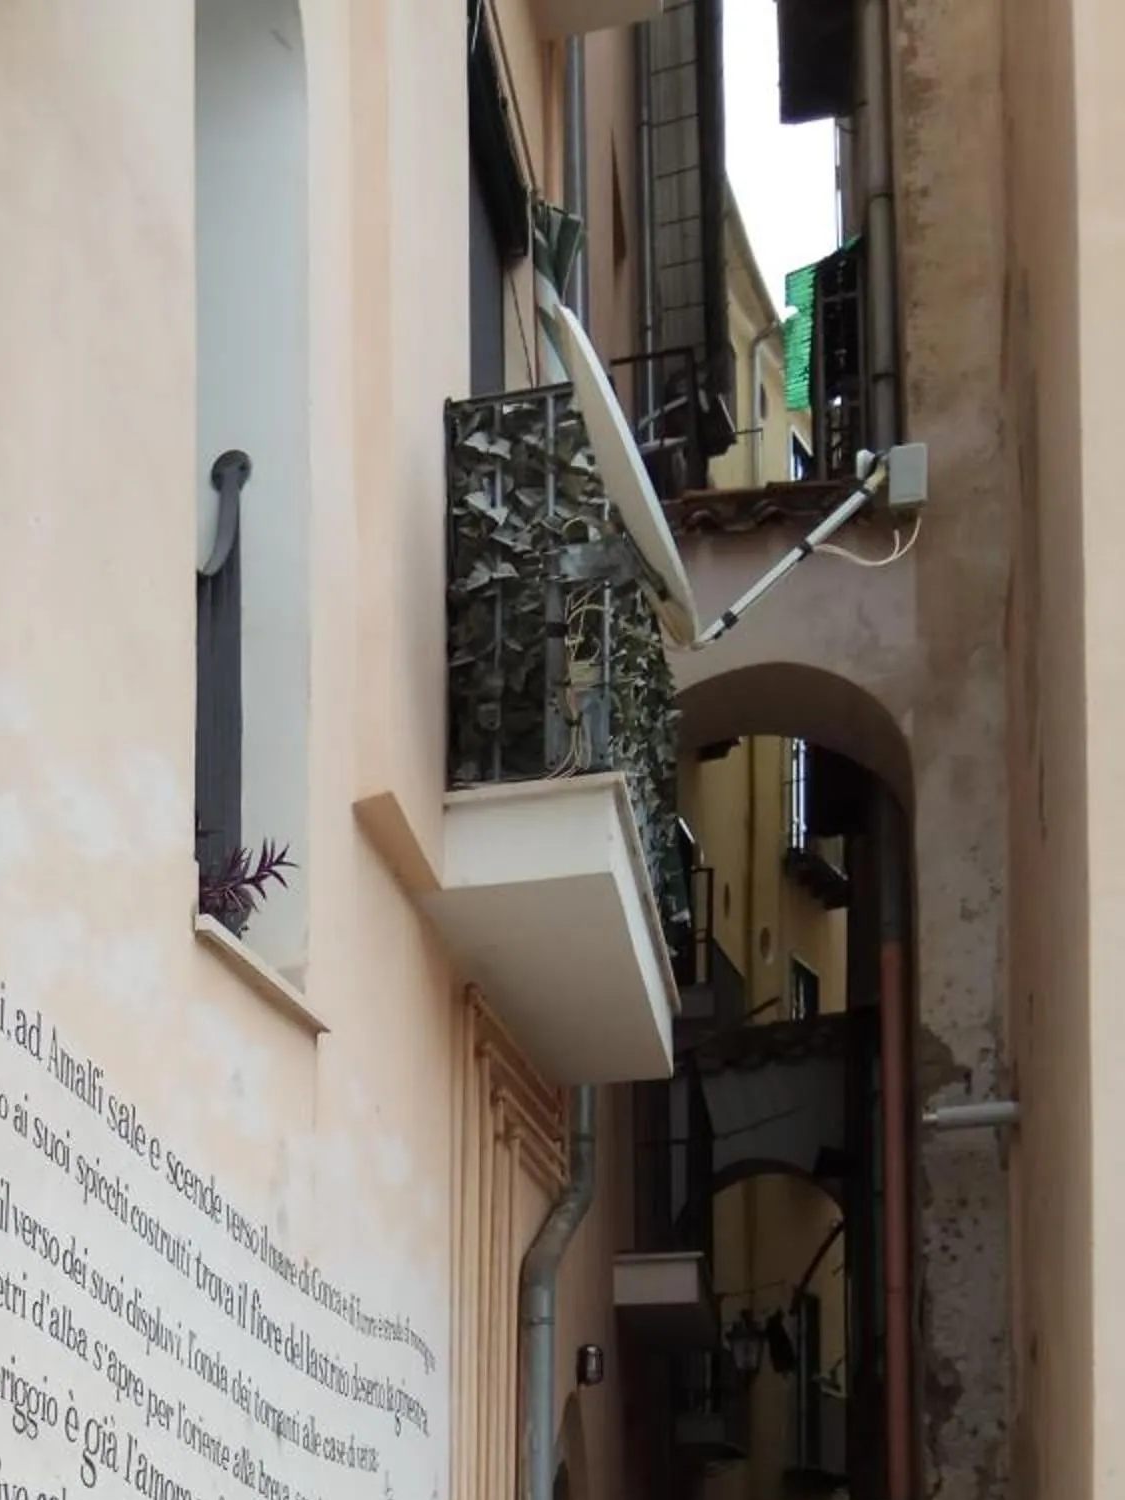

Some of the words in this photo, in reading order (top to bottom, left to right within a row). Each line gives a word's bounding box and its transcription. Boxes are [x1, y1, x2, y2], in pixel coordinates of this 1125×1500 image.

[13, 1094, 29, 1137] ai
[32, 1117, 71, 1175] suoi
[75, 1155, 129, 1222] spicchi
[130, 1203, 192, 1279] costrutti
[195, 1252, 236, 1319] trova
[238, 1282, 248, 1329] il
[250, 1288, 282, 1356] fiore
[285, 1322, 304, 1371] del
[15, 1006, 42, 1062] ad
[47, 1026, 105, 1115] Amalfi
[108, 1095, 147, 1157] sale
[149, 1137, 161, 1170] e
[165, 1148, 223, 1226] scende
[226, 1203, 259, 1255] verso
[260, 1225, 268, 1263] il
[12, 1206, 60, 1266] verso
[62, 1236, 88, 1288] dei
[90, 1270, 124, 1318] suoi
[187, 1328, 229, 1394] l'onda
[230, 1369, 251, 1416] dei
[302, 1414, 321, 1456] alle
[31, 1289, 90, 1362] d'alba
[93, 1339, 145, 1409] s'apre
[146, 1383, 175, 1432] per
[176, 1401, 230, 1471] l'oriente
[232, 1445, 256, 1489] alla
[63, 1389, 79, 1443] è
[80, 1412, 119, 1489] già
